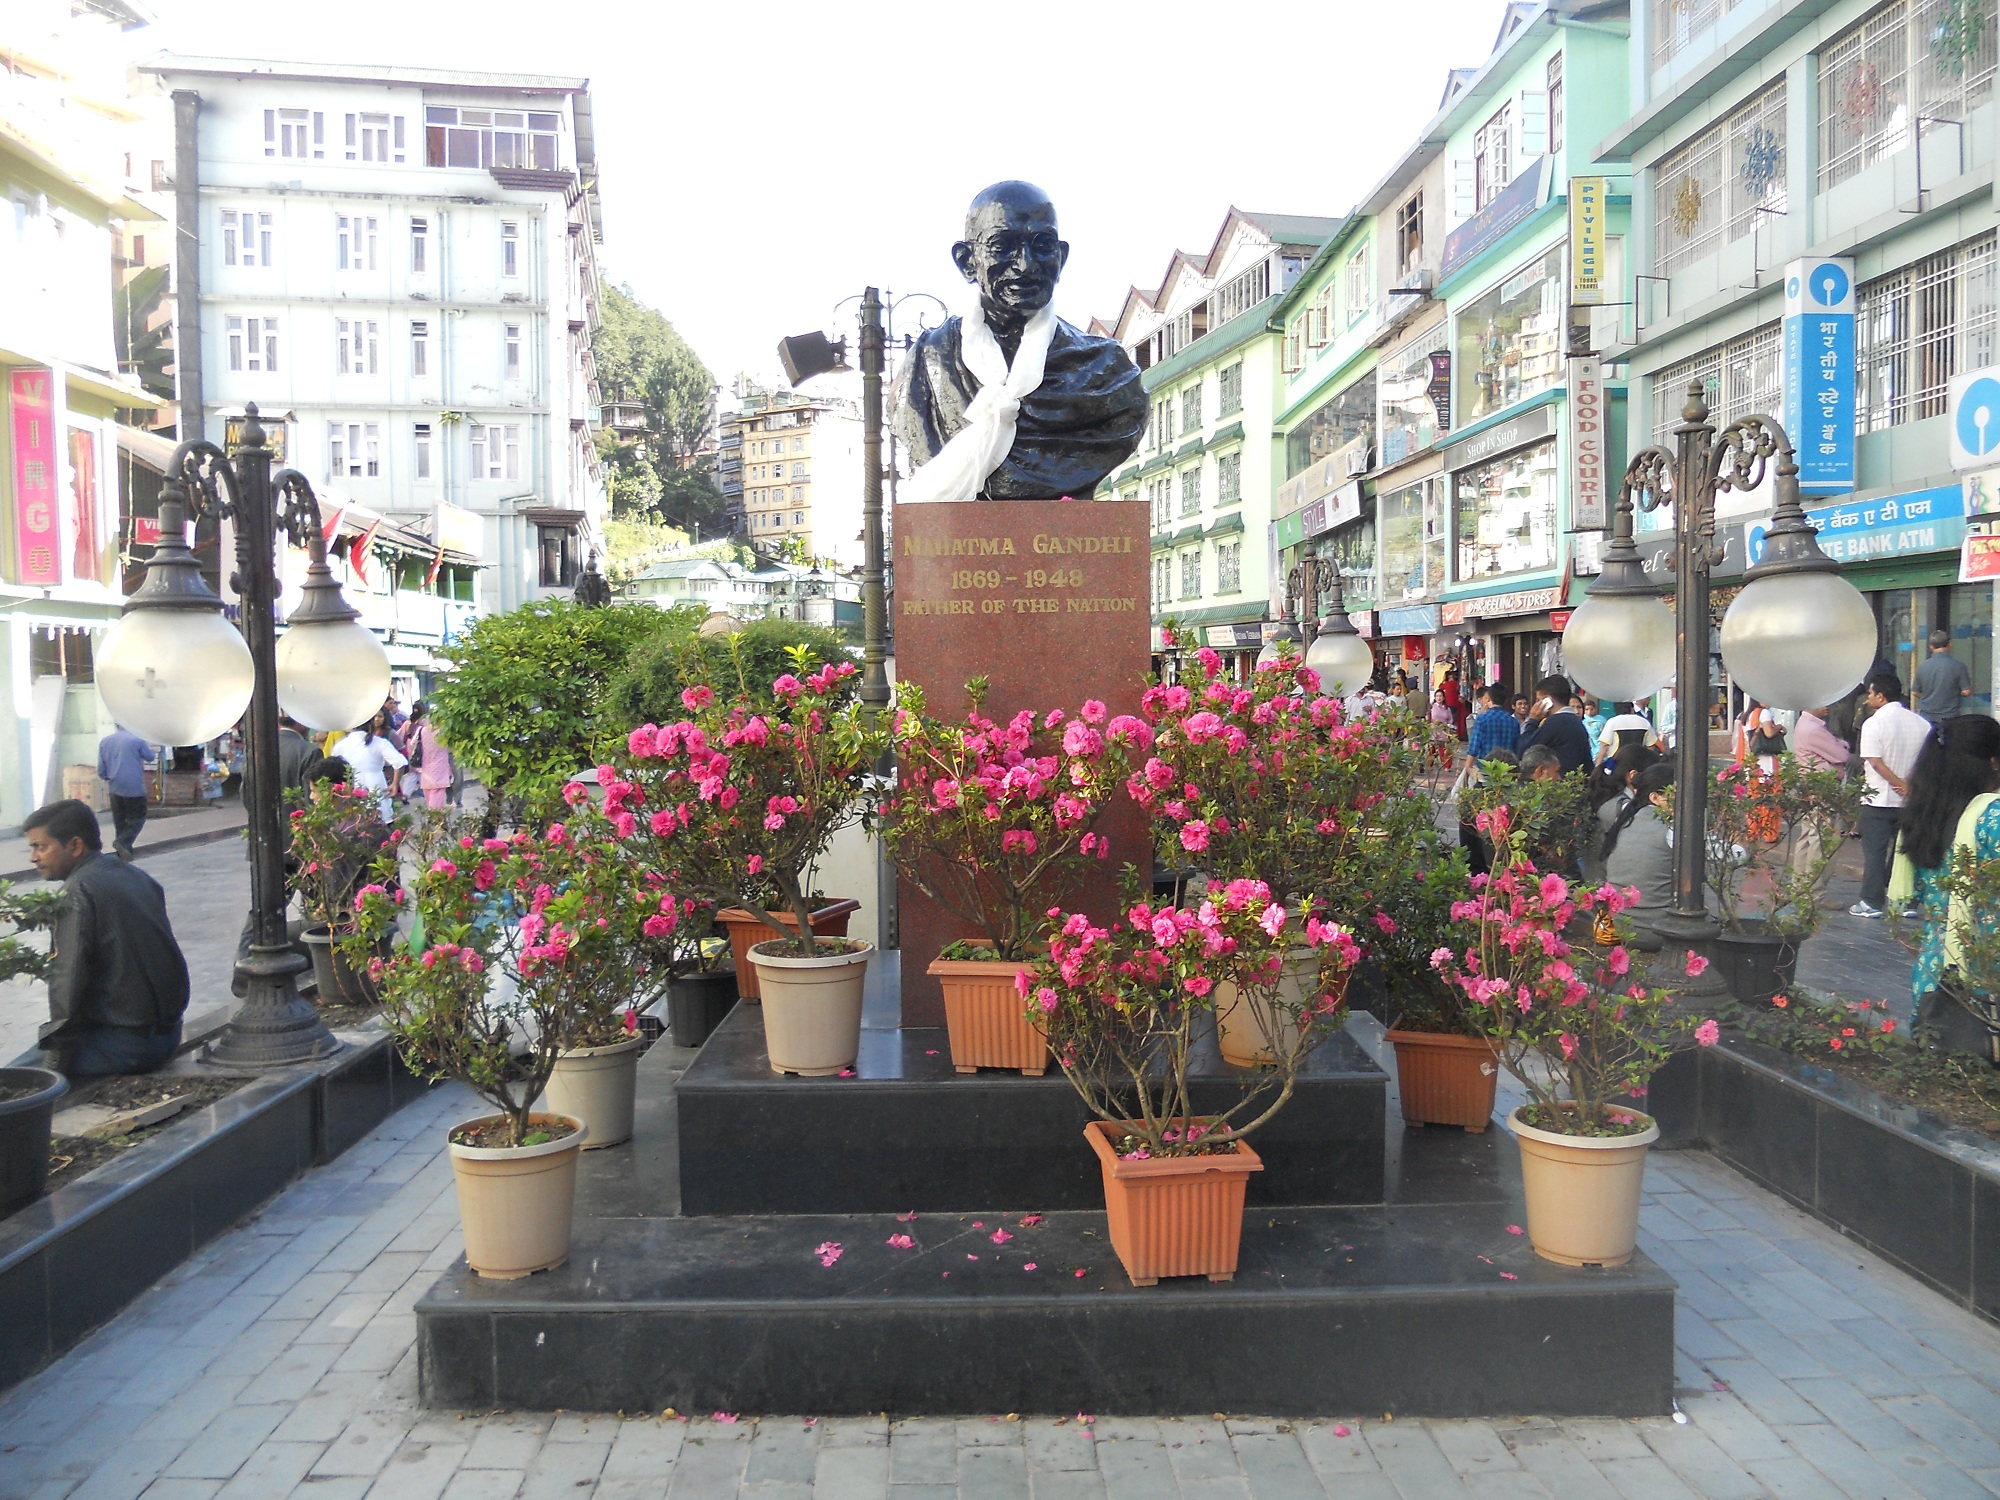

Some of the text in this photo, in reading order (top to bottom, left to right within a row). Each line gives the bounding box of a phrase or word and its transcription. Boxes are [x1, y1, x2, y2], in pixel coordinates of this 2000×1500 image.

[1582, 186, 1595, 275] PRIVILEGE
[1820, 322, 1838, 381] भारतीय
[1790, 402, 1797, 416] OF
[1818, 387, 1839, 418] स्टेट
[1497, 428, 1518, 447] SHOP
[1577, 380, 1599, 506] FOOD COURT
[1819, 424, 1837, 455] बैंक
[21, 379, 51, 575] VIRGO
[1302, 504, 1325, 534] STYLE
[1578, 508, 1600, 516] PURE
[1579, 516, 1597, 524] VEG
[1830, 509, 1859, 528] बैंक
[1863, 510, 1875, 526] ए
[1880, 501, 1899, 521] टी
[1904, 500, 1931, 519] एम
[904, 533, 1132, 556] MAHATMA GANDHI
[1848, 534, 1893, 556] BANK
[1897, 528, 1934, 550] ATM
[951, 570, 1001, 589] 1869
[1024, 569, 1084, 588] 1948
[902, 597, 1137, 615] FATHER OF THE NATION
[1468, 592, 1553, 613] DARJEELING STORES
